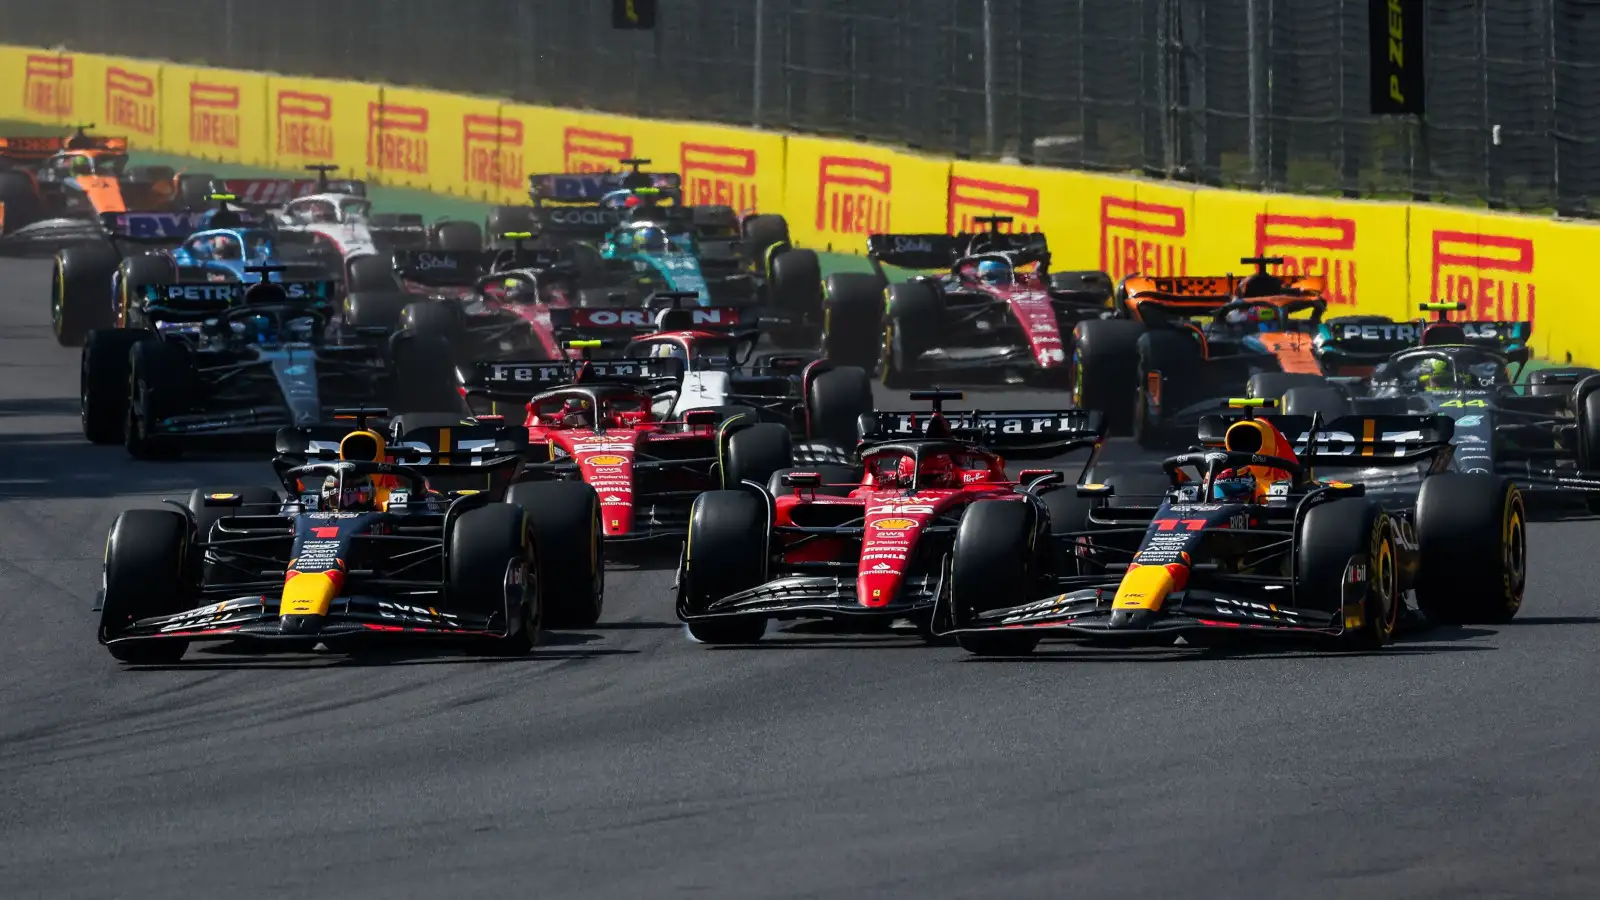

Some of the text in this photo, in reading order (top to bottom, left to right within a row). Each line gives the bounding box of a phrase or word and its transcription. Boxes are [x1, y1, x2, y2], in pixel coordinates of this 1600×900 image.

[24, 55, 74, 117] PIRELLI
[105, 66, 156, 136] PIRELLI
[1389, 74, 1405, 104] P
[190, 82, 240, 149] PIRELLI
[277, 90, 334, 160] PIRELLI
[366, 101, 430, 175] PIRELLI
[463, 114, 524, 190] PIRELLI
[816, 156, 892, 234] PIRELLI
[1100, 195, 1186, 284] PIRELLI
[168, 284, 306, 301] PETRS
[1430, 229, 1536, 334] PIRELLI
[588, 307, 722, 327] ORN
[1343, 323, 1497, 340] PETRAS
[490, 361, 652, 382] Ferri
[1439, 399, 1489, 408] 44
[895, 413, 1072, 435] Frari
[1282, 418, 1421, 457] BIT
[305, 428, 497, 467] BBIT
[573, 442, 635, 455] 55
[865, 504, 934, 517] 16
[1152, 518, 1208, 531] 11
[309, 526, 340, 538] 1
